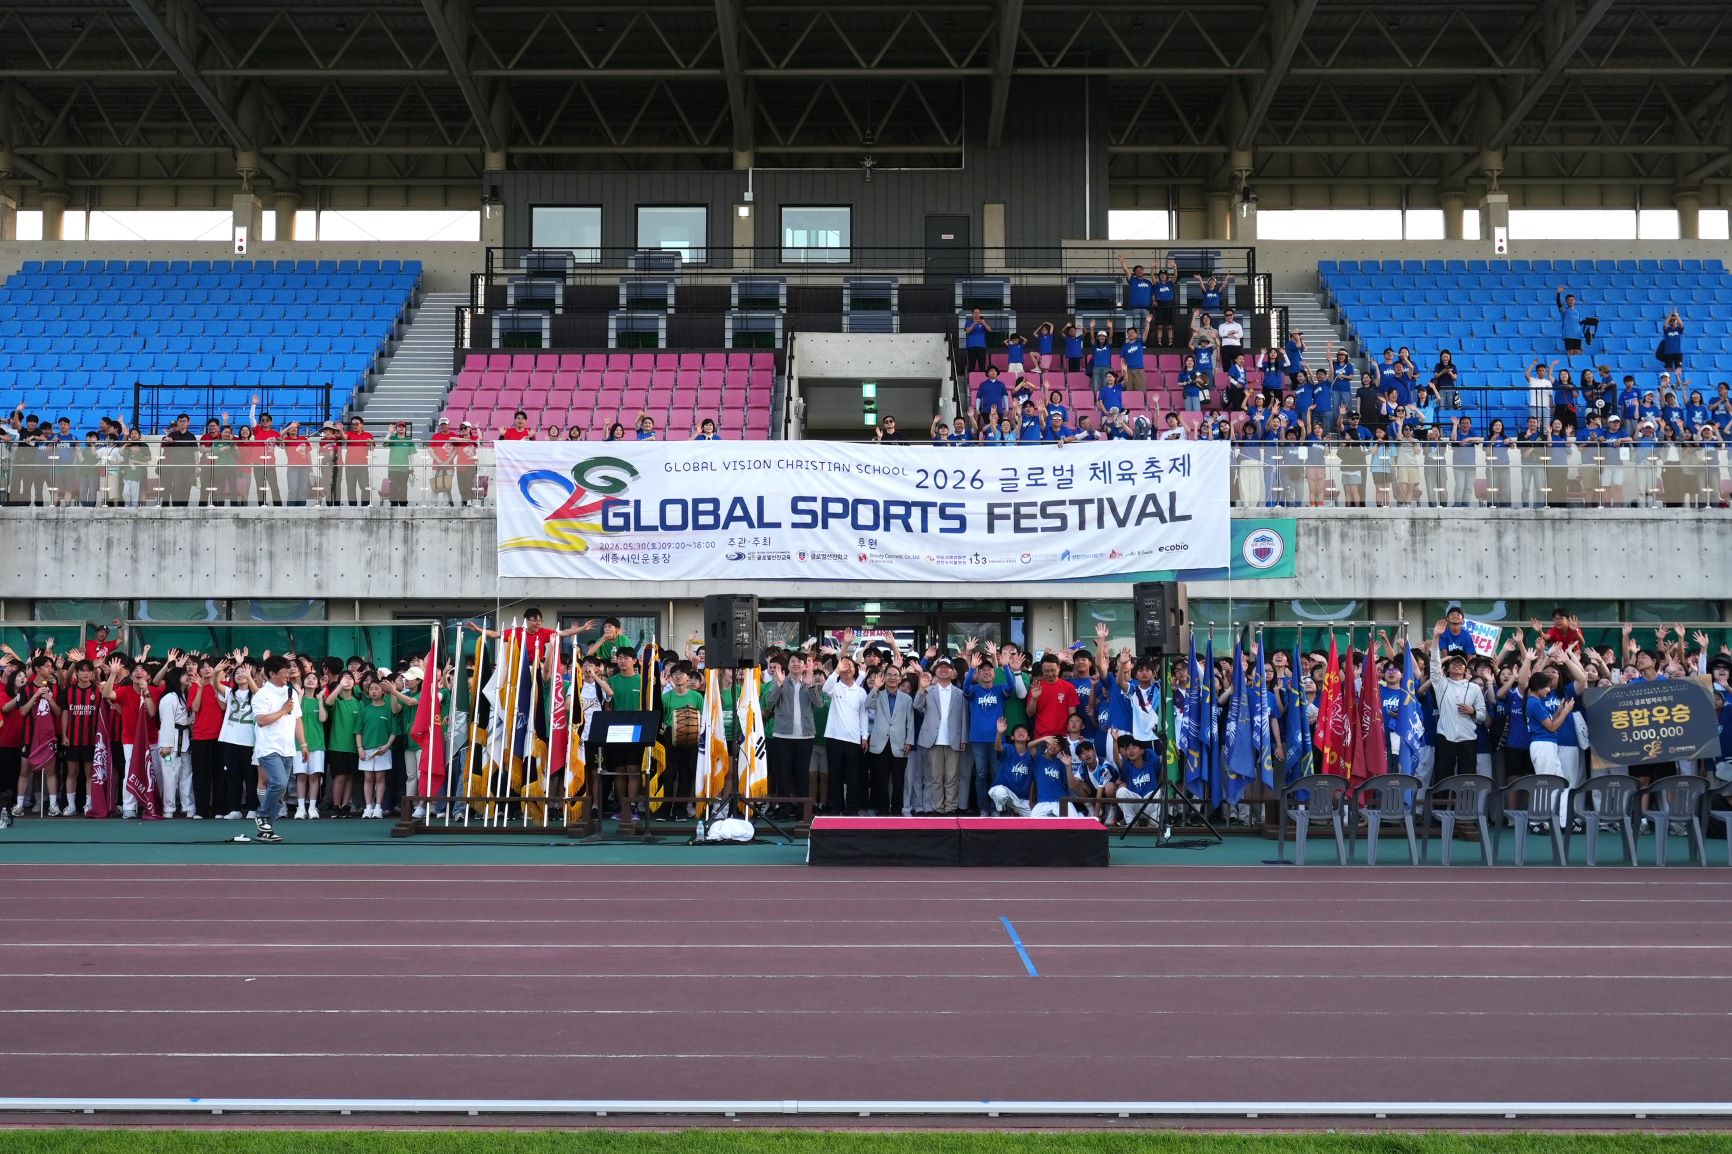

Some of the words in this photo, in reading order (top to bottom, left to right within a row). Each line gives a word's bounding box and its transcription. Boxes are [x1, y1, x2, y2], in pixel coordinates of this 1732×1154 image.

[664, 461, 717, 472] GLOBAL
[723, 459, 772, 471] VISION
[777, 459, 851, 473] CHRISTIAN
[856, 463, 909, 476] SCHOOL
[915, 468, 985, 490] 2026
[999, 464, 1074, 493] 글로벌
[1088, 453, 1191, 486] 체육축제
[601, 495, 782, 533] GLOBAL
[790, 495, 967, 534] SPORTS
[986, 491, 1192, 534] FESTIVAL
[1158, 542, 1189, 553] ecobio
[228, 699, 254, 724] 22
[1611, 704, 1691, 729] 종합우승
[1620, 726, 1684, 743] 3,000,000
